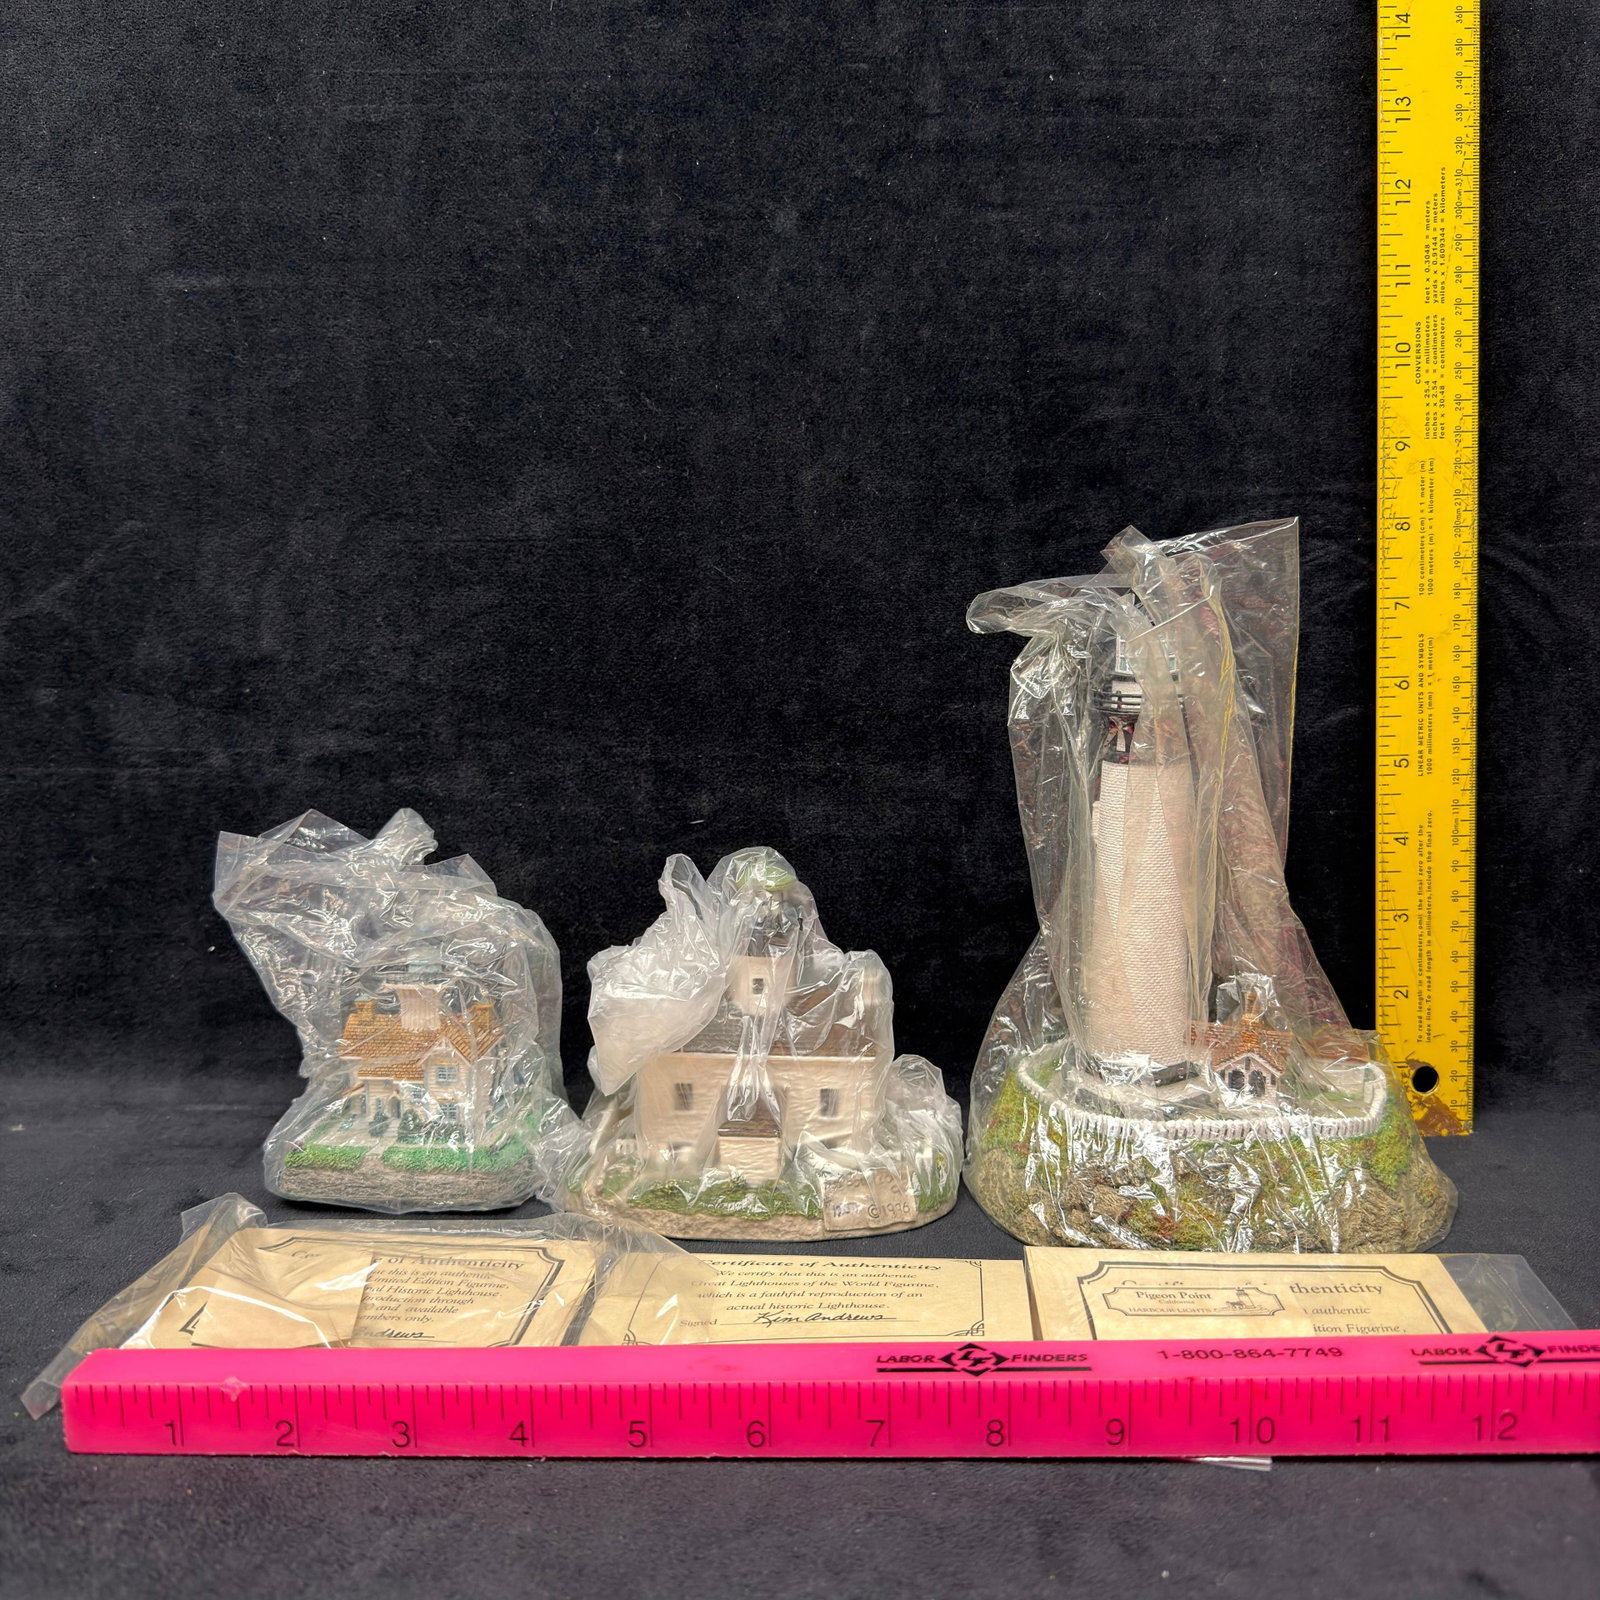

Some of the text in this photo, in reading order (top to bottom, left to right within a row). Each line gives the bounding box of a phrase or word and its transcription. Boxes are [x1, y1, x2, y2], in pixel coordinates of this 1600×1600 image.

[1395, 13, 1410, 40] 14
[1395, 96, 1411, 123] 13
[1395, 179, 1410, 206] 12
[1396, 265, 1410, 288] 11
[1395, 342, 1410, 369] 10
[1395, 442, 1410, 451] 9
[1395, 521, 1410, 531] 8
[1453, 509, 1461, 537] 200mm
[1395, 602, 1410, 610] 7
[1394, 680, 1410, 690] 6
[1394, 758, 1409, 768] 5
[1394, 837, 1408, 846] 4
[1452, 860, 1459, 872] 90
[1394, 913, 1408, 922] 3
[1451, 981, 1458, 992] 50
[1394, 990, 1408, 999] 2
[1426, 994, 1432, 1002] To
[1451, 1040, 1458, 1052] 30
[823, 1262, 941, 1270] Authenticity
[1290, 1283, 1382, 1294] thenticity
[362, 1295, 425, 1304] production
[1135, 1291, 1176, 1300] Pigeon
[1312, 1306, 1370, 1315] authentic
[753, 1310, 799, 1328] Kim
[1313, 1325, 1342, 1333] ition
[1159, 1348, 1342, 1359] 1-800-864-7749
[1411, 1348, 1471, 1356] LABOR
[876, 1355, 935, 1363] LABOR
[1011, 1354, 1088, 1362] FINDERS
[164, 1422, 176, 1445] 1
[392, 1421, 410, 1446] 3
[509, 1421, 529, 1446] 4
[866, 1420, 885, 1447] 7
[986, 1419, 1005, 1447] 8
[1106, 1418, 1125, 1446] 9
[1231, 1417, 1275, 1444] 10
[1353, 1416, 1390, 1443] 11
[1473, 1414, 1517, 1441] 12
[275, 1421, 293, 1447] 2
[628, 1421, 646, 1448] 5
[747, 1421, 765, 1448] 6
